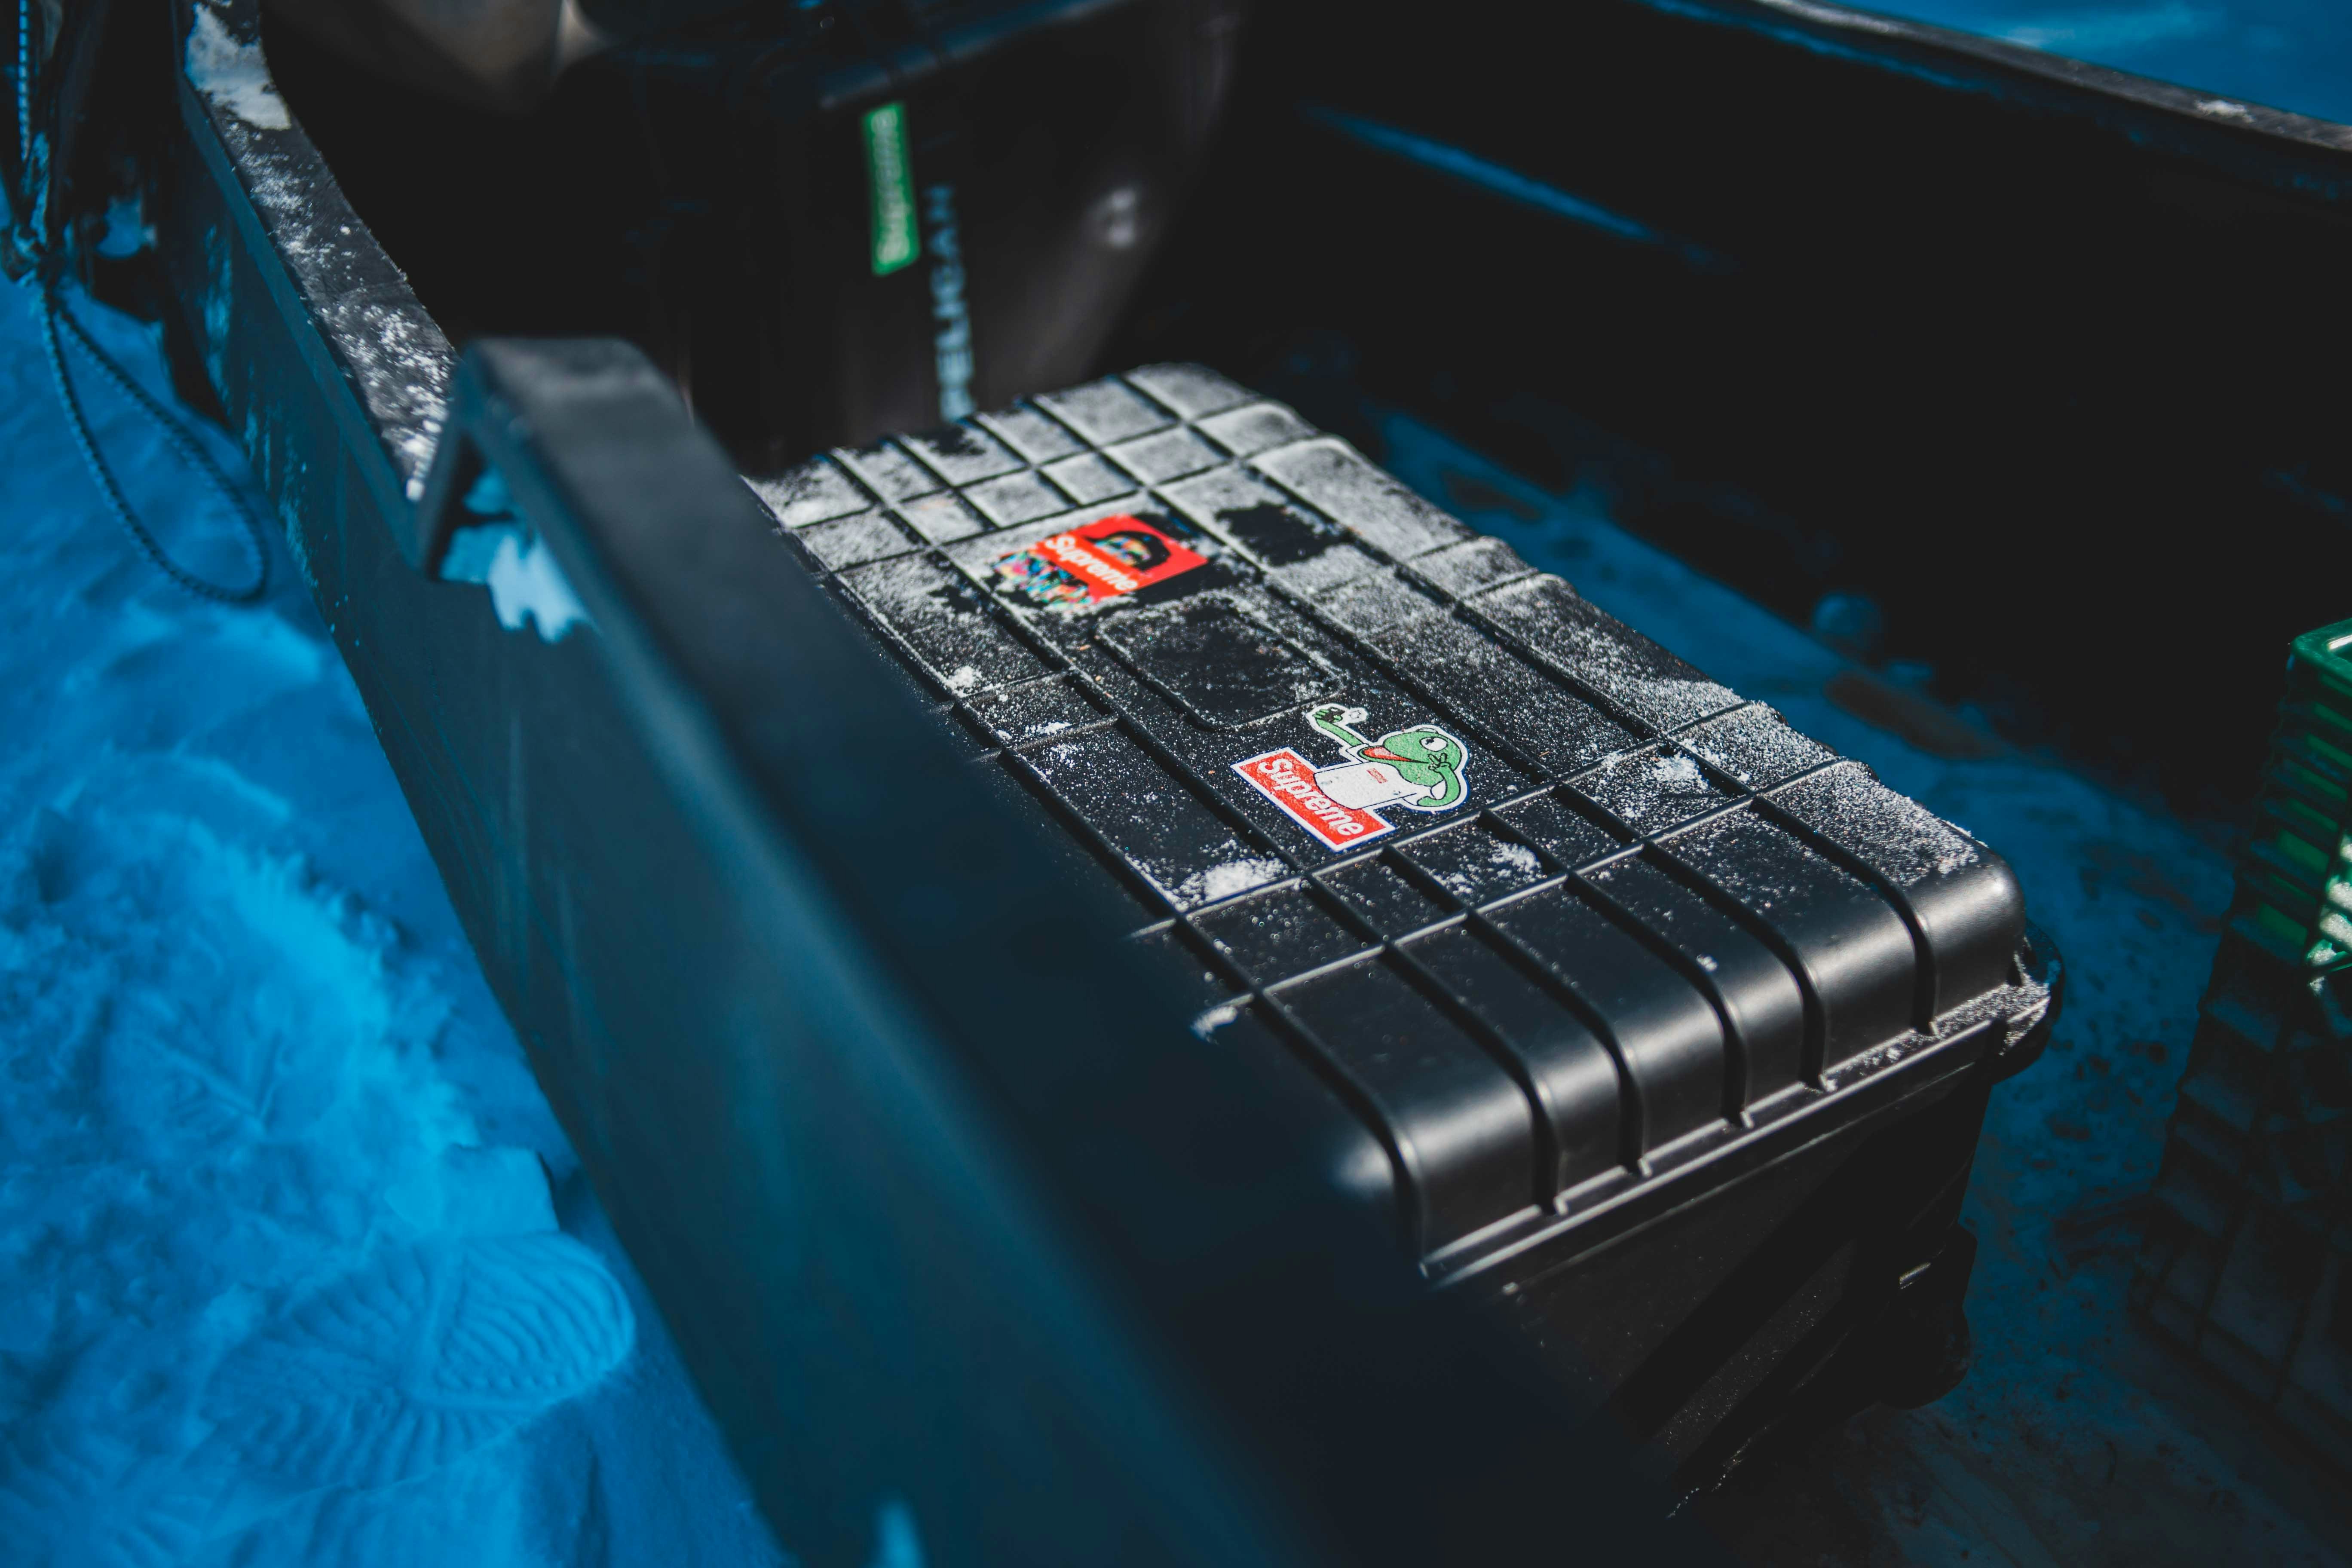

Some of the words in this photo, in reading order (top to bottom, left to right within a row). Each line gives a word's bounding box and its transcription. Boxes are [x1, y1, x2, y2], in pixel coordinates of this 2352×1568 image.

[871, 108, 910, 264] Supreme
[926, 186, 976, 424] PELICAN
[1045, 535, 1138, 591] Supreme
[1257, 757, 1364, 836] Supreme
